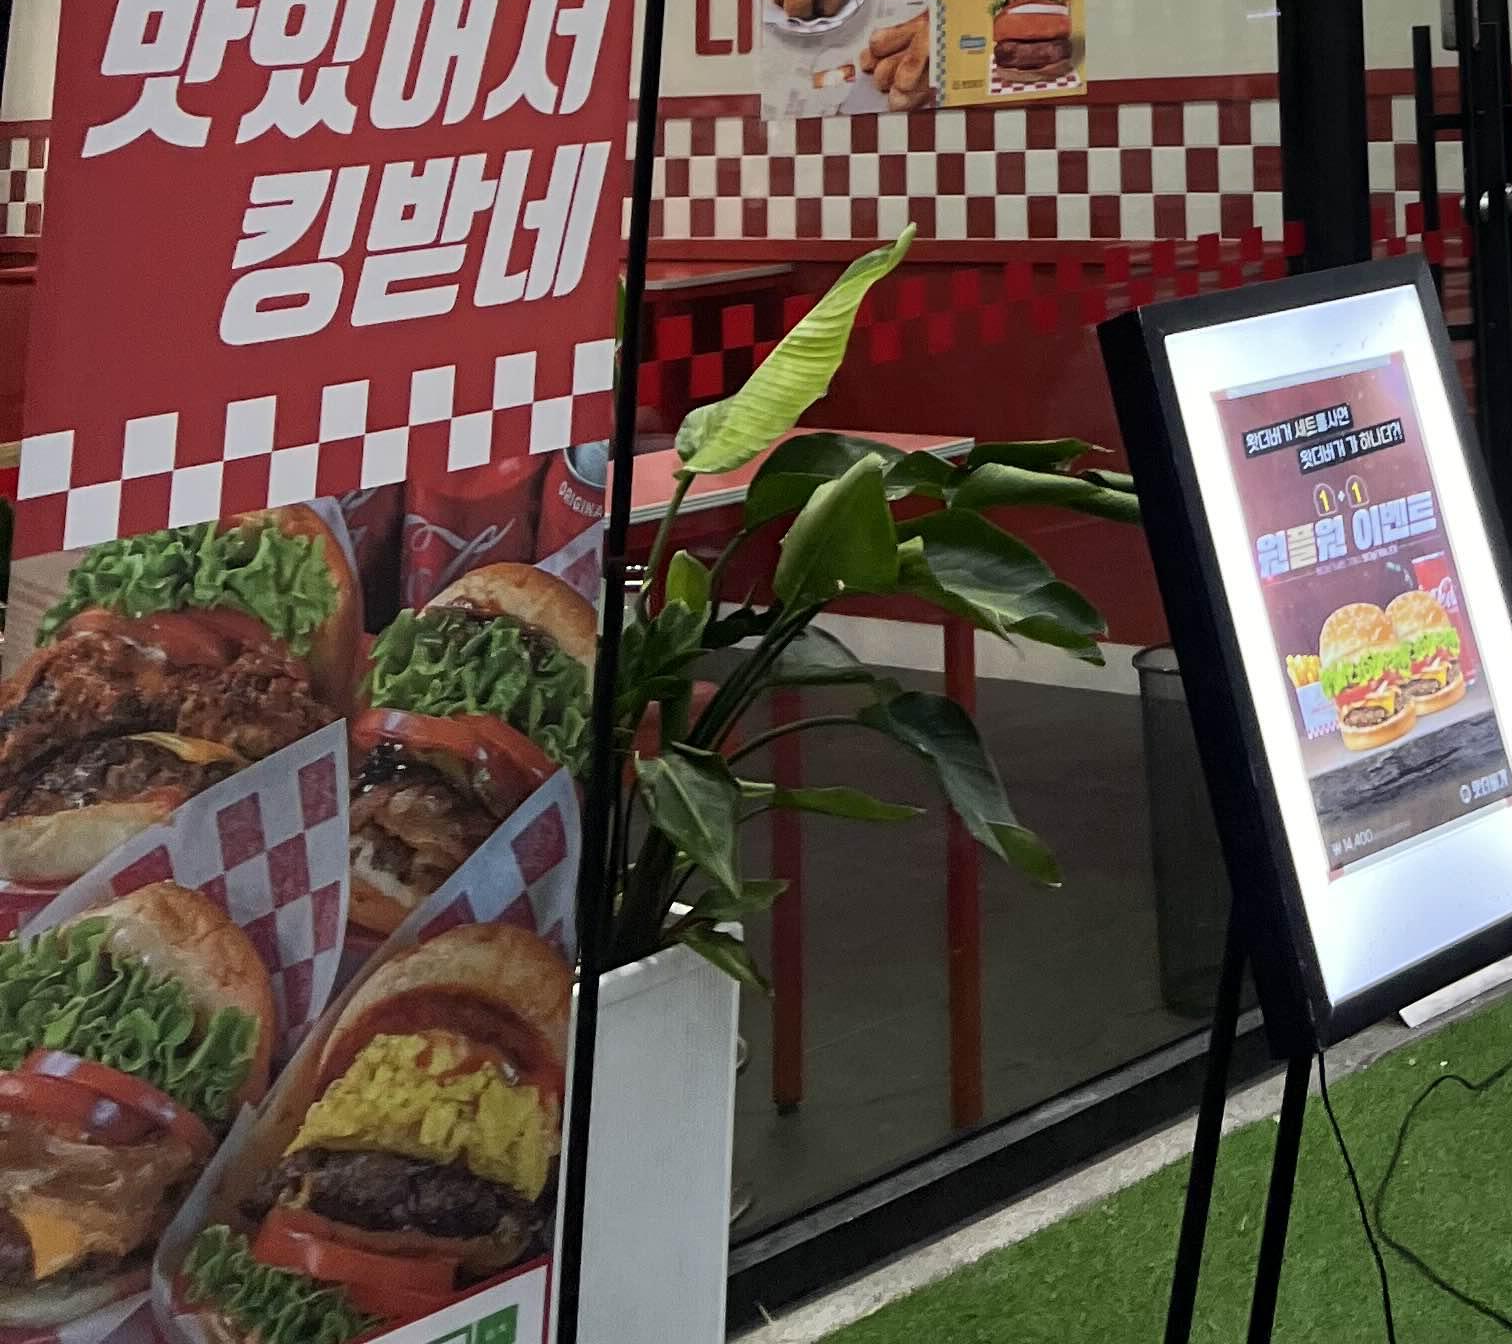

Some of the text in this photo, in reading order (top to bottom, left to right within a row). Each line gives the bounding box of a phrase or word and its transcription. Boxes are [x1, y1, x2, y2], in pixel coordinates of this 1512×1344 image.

[217, 140, 613, 347] 킹받네
[1256, 514, 1348, 579] 원플원
[1352, 490, 1437, 552] 이벤트
